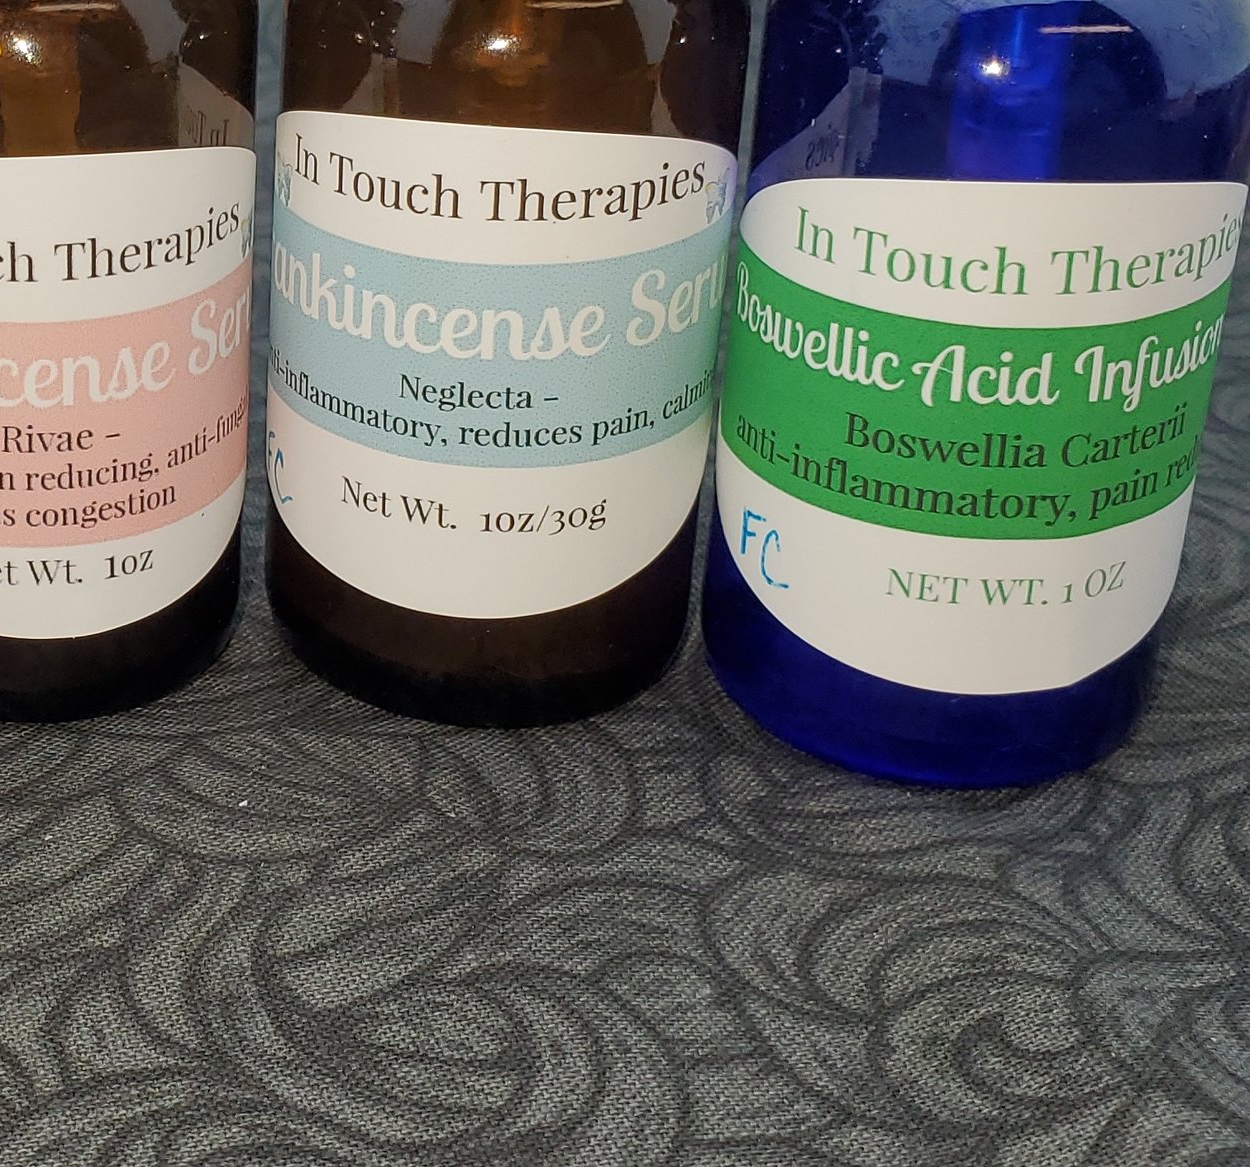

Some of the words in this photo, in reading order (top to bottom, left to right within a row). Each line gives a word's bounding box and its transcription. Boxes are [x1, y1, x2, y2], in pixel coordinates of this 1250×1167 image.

[294, 133, 319, 185] In
[330, 152, 463, 220] Touch
[480, 161, 706, 223] Therapies
[54, 201, 240, 282] Therapies
[795, 206, 836, 264] In
[853, 227, 1028, 296] Touch
[736, 261, 906, 391] Boswellic
[911, 345, 1060, 407] Acid
[399, 374, 534, 412] Neglecta
[1, 425, 94, 454] Rivae
[458, 422, 583, 448] reduces
[592, 413, 655, 445] pain,
[844, 412, 1047, 469] Boswellia
[1061, 403, 1188, 468] Carterii
[25, 453, 160, 492] reducing,
[736, 413, 1077, 527] anti-inflammatory,
[1089, 472, 1159, 519] pain
[25, 483, 176, 529] congestion
[340, 475, 392, 519] Net
[401, 494, 457, 530] Wt.
[480, 498, 607, 537] 1oz/30g
[27, 559, 82, 586] Wt.
[739, 506, 789, 589] FC
[887, 567, 968, 605] NET
[980, 576, 1050, 606] WT.
[1062, 584, 1073, 603] 1
[1084, 560, 1128, 598] OZ
